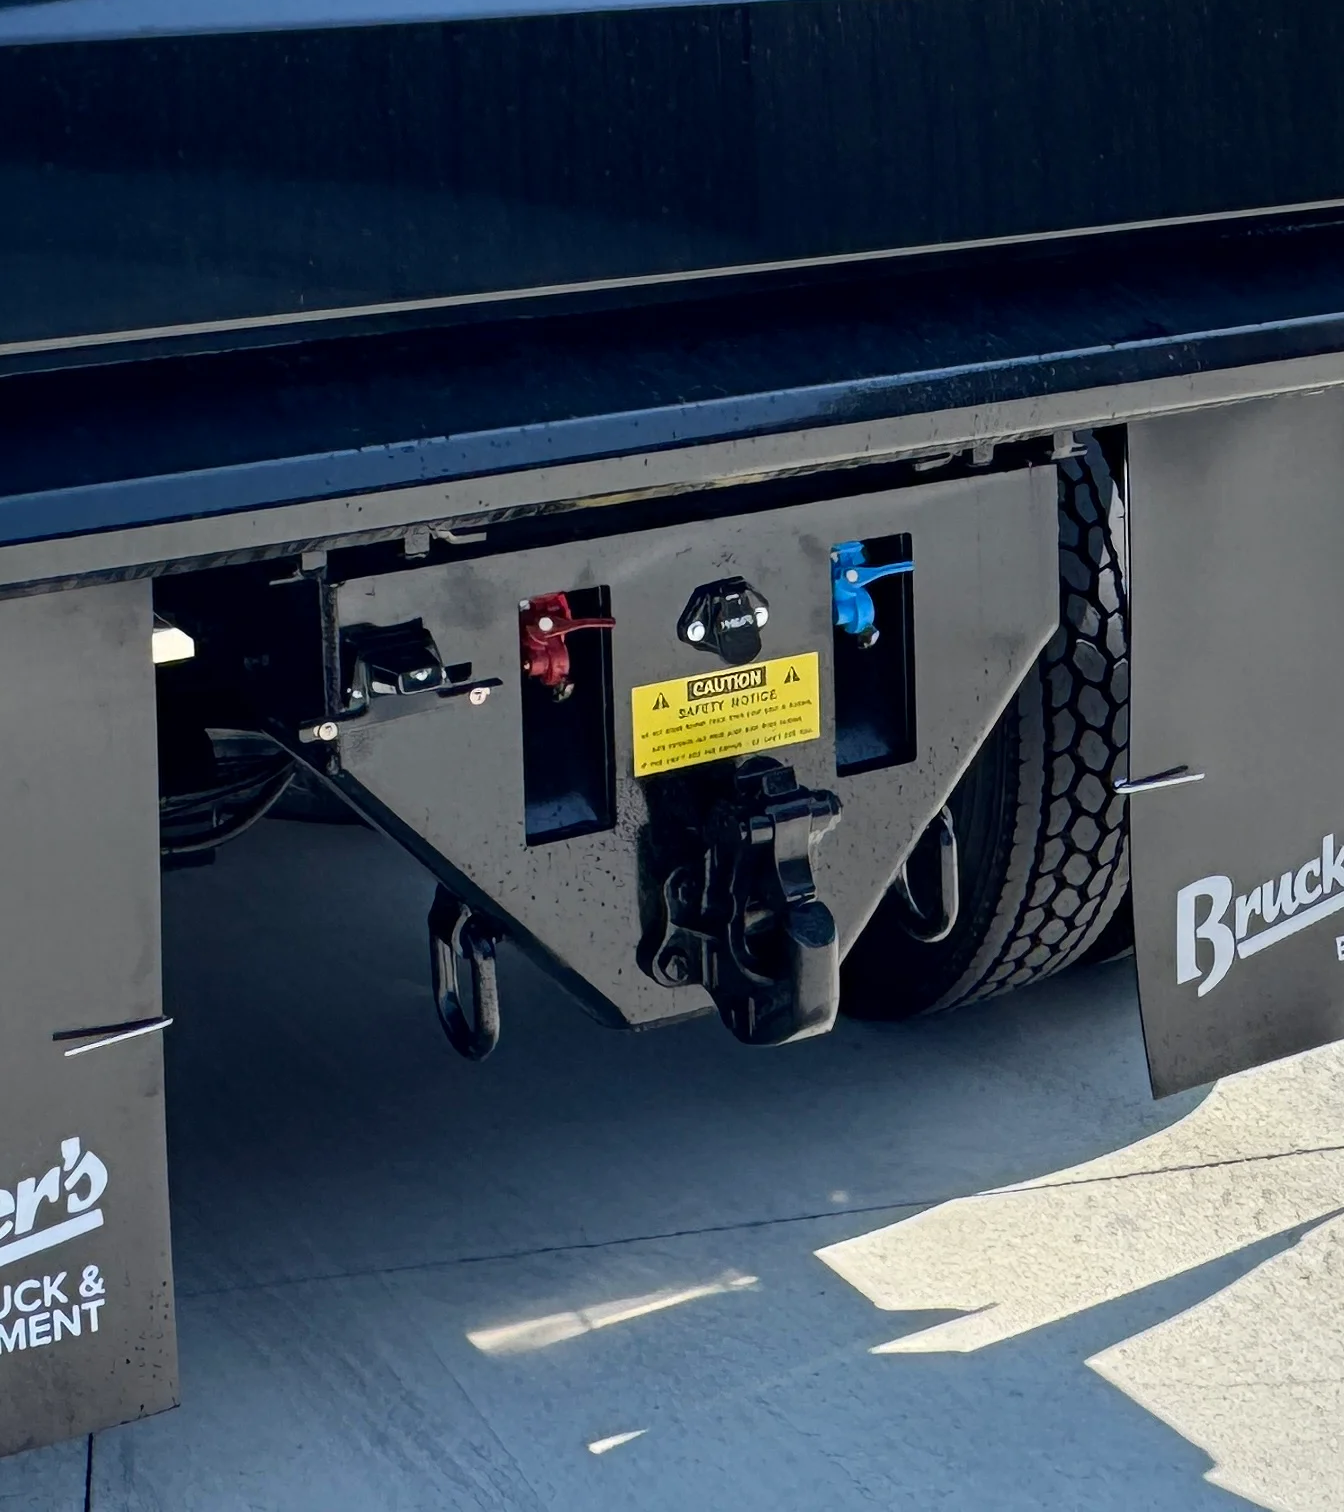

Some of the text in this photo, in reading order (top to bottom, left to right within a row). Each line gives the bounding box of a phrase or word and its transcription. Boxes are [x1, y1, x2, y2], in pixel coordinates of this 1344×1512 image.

[692, 669, 762, 697] CAUTION
[678, 700, 724, 719] SAFETY
[731, 689, 777, 708] NOTICE
[79, 1264, 106, 1297] &
